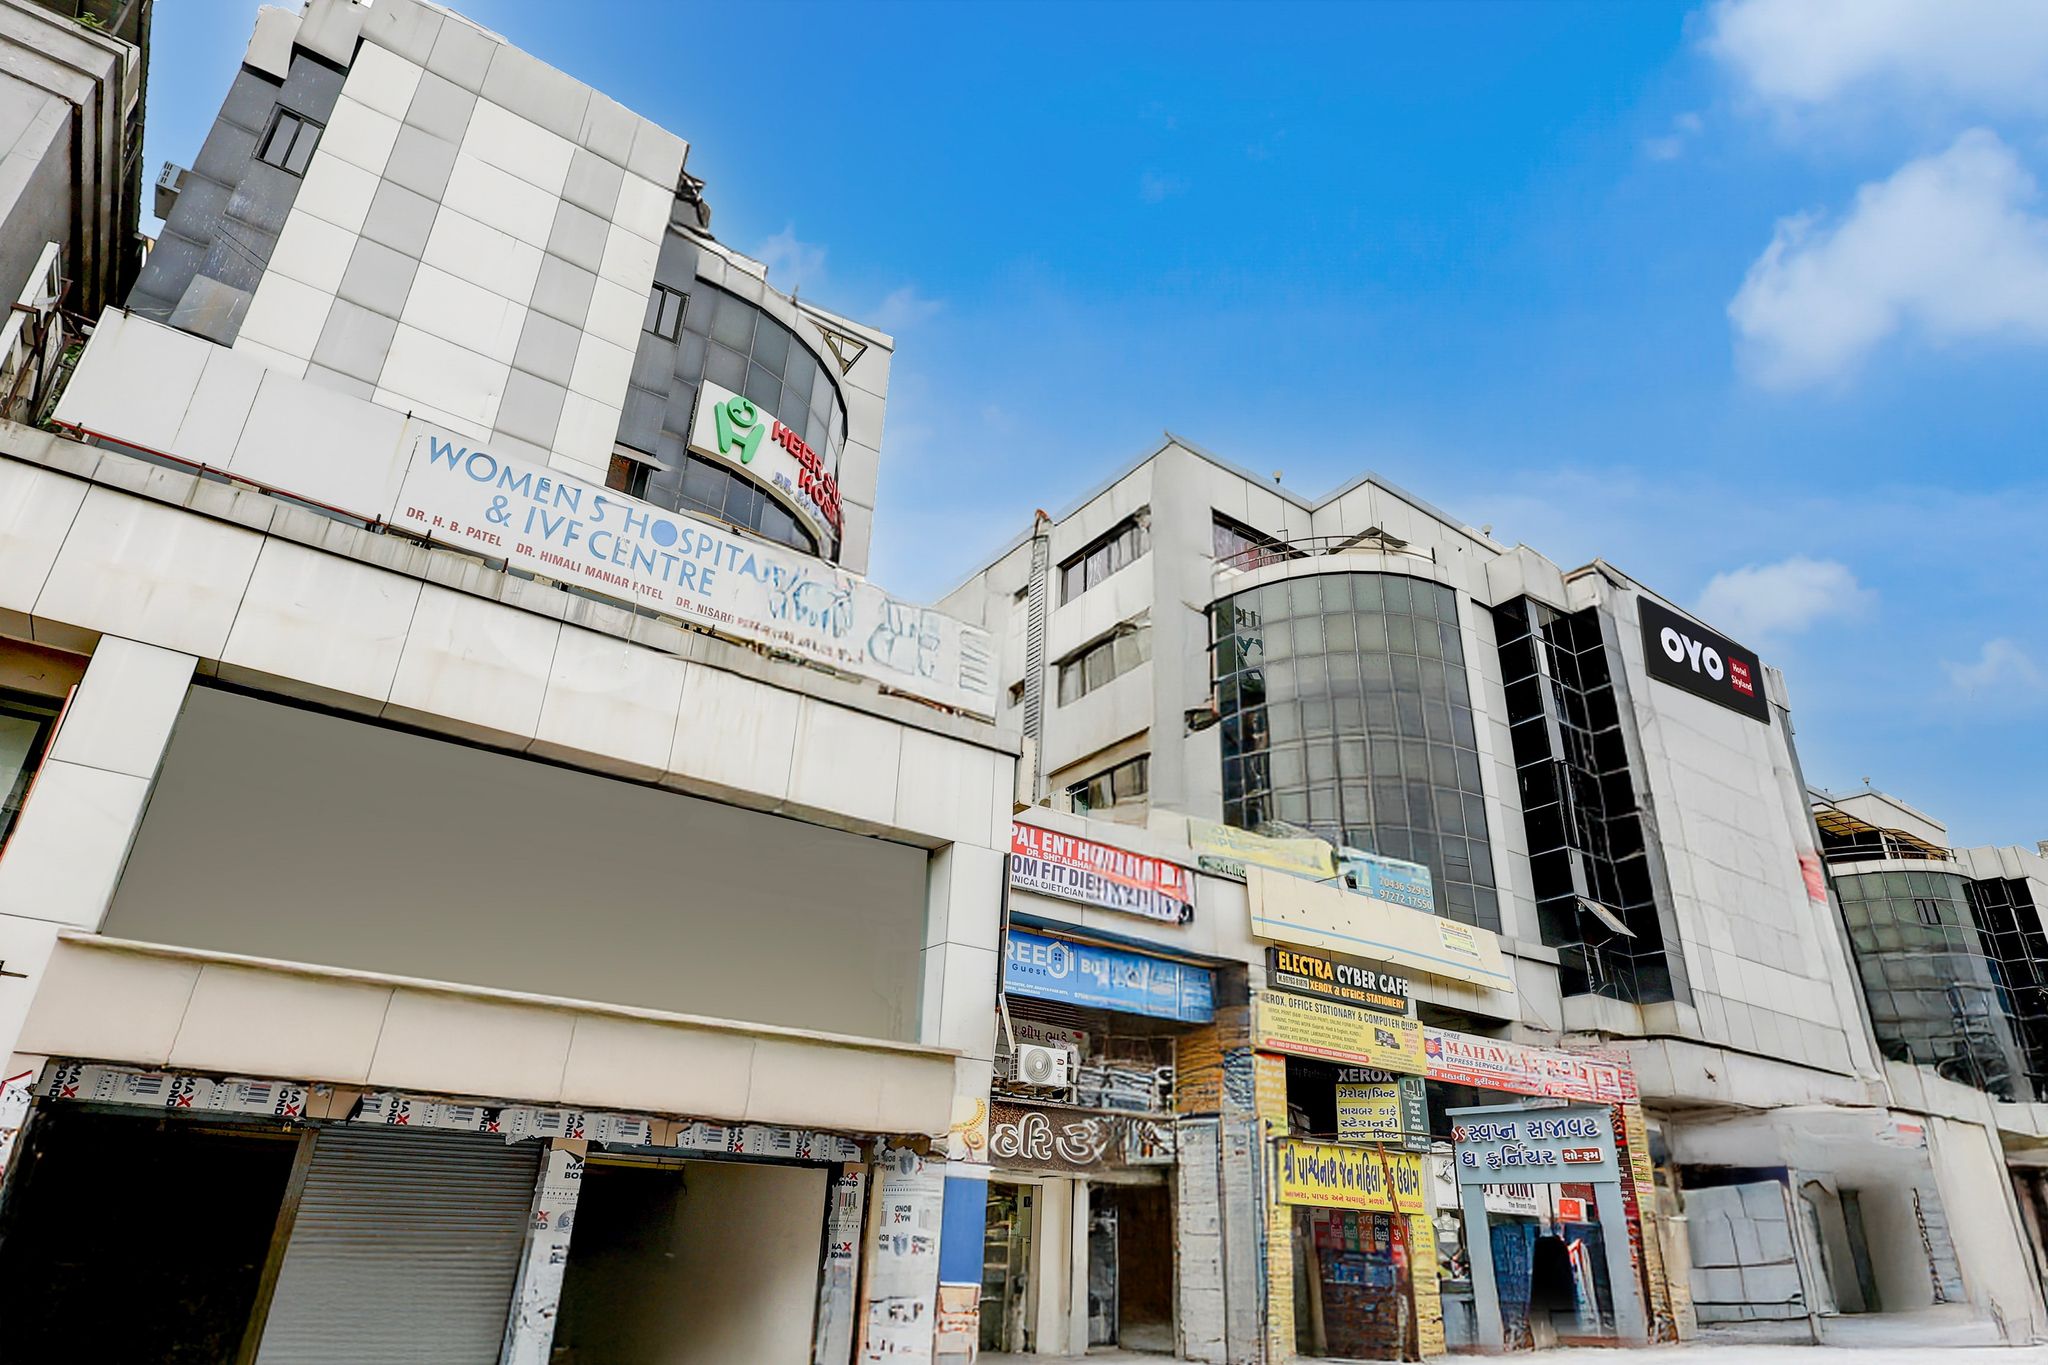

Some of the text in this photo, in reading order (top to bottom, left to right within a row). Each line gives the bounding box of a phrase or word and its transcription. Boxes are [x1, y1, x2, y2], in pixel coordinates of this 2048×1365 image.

[485, 495, 717, 597] & IVF CENTRE
[406, 507, 427, 523] DR.
[432, 516, 445, 529] H.
[450, 521, 461, 533] B.
[466, 527, 502, 548] PATEL
[516, 542, 535, 558] DR.
[540, 550, 581, 574] HIMALI
[585, 566, 629, 589] MANIAR
[676, 596, 693, 611] DR.
[1660, 627, 1724, 681] OYO
[1732, 663, 1747, 677] Hotel
[1731, 675, 1753, 692] Skyland
[1026, 848, 1041, 858] DR.
[1042, 832, 1076, 857] ENT
[1041, 861, 1066, 883] FIT
[1012, 963, 1046, 976] Guest
[1279, 951, 1408, 996] ELECTRA CYBER CAFE
[1309, 980, 1333, 994] XEROX
[1288, 996, 1313, 1012] OFFICE
[1314, 1001, 1356, 1020] STATIONARY
[1358, 1012, 1364, 1022] &
[1338, 1068, 1394, 1082] XEROX
[1526, 1117, 1600, 1140] સજાવટ
[894, 1213, 911, 1223] MAX
